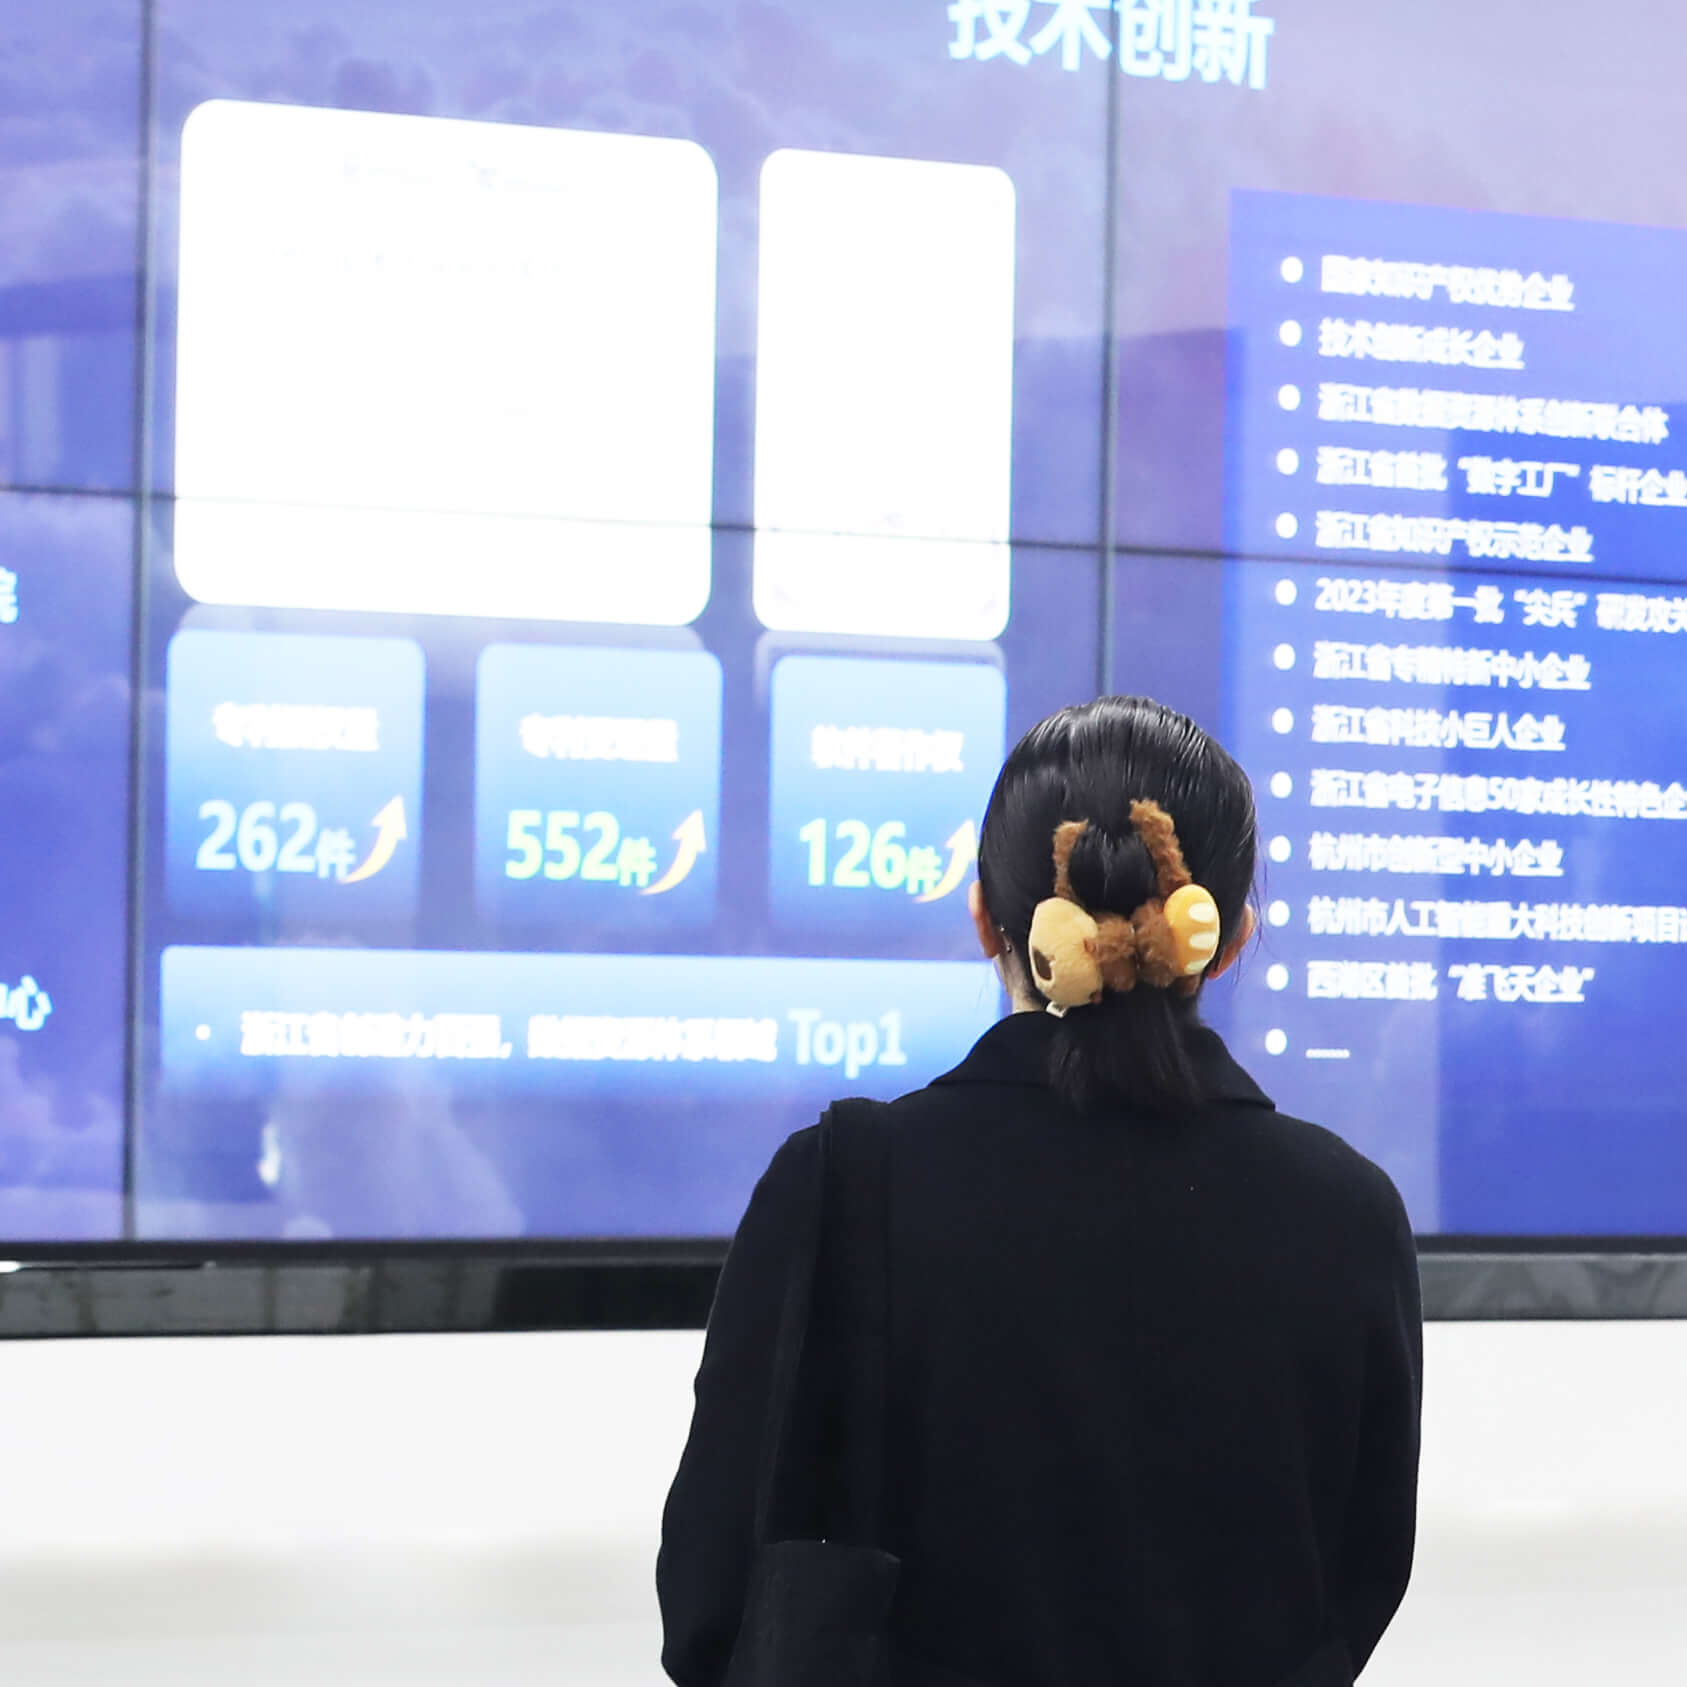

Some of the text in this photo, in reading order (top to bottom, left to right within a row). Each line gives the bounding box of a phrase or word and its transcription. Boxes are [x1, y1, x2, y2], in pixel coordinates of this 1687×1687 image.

[946, 0, 1275, 90] 技术创新
[1312, 704, 1565, 750] 浙江省科技小巨人企业
[196, 799, 356, 880] 262件
[505, 809, 657, 887] 552件
[0, 975, 53, 1031] 心
[787, 1007, 908, 1081] Top1
